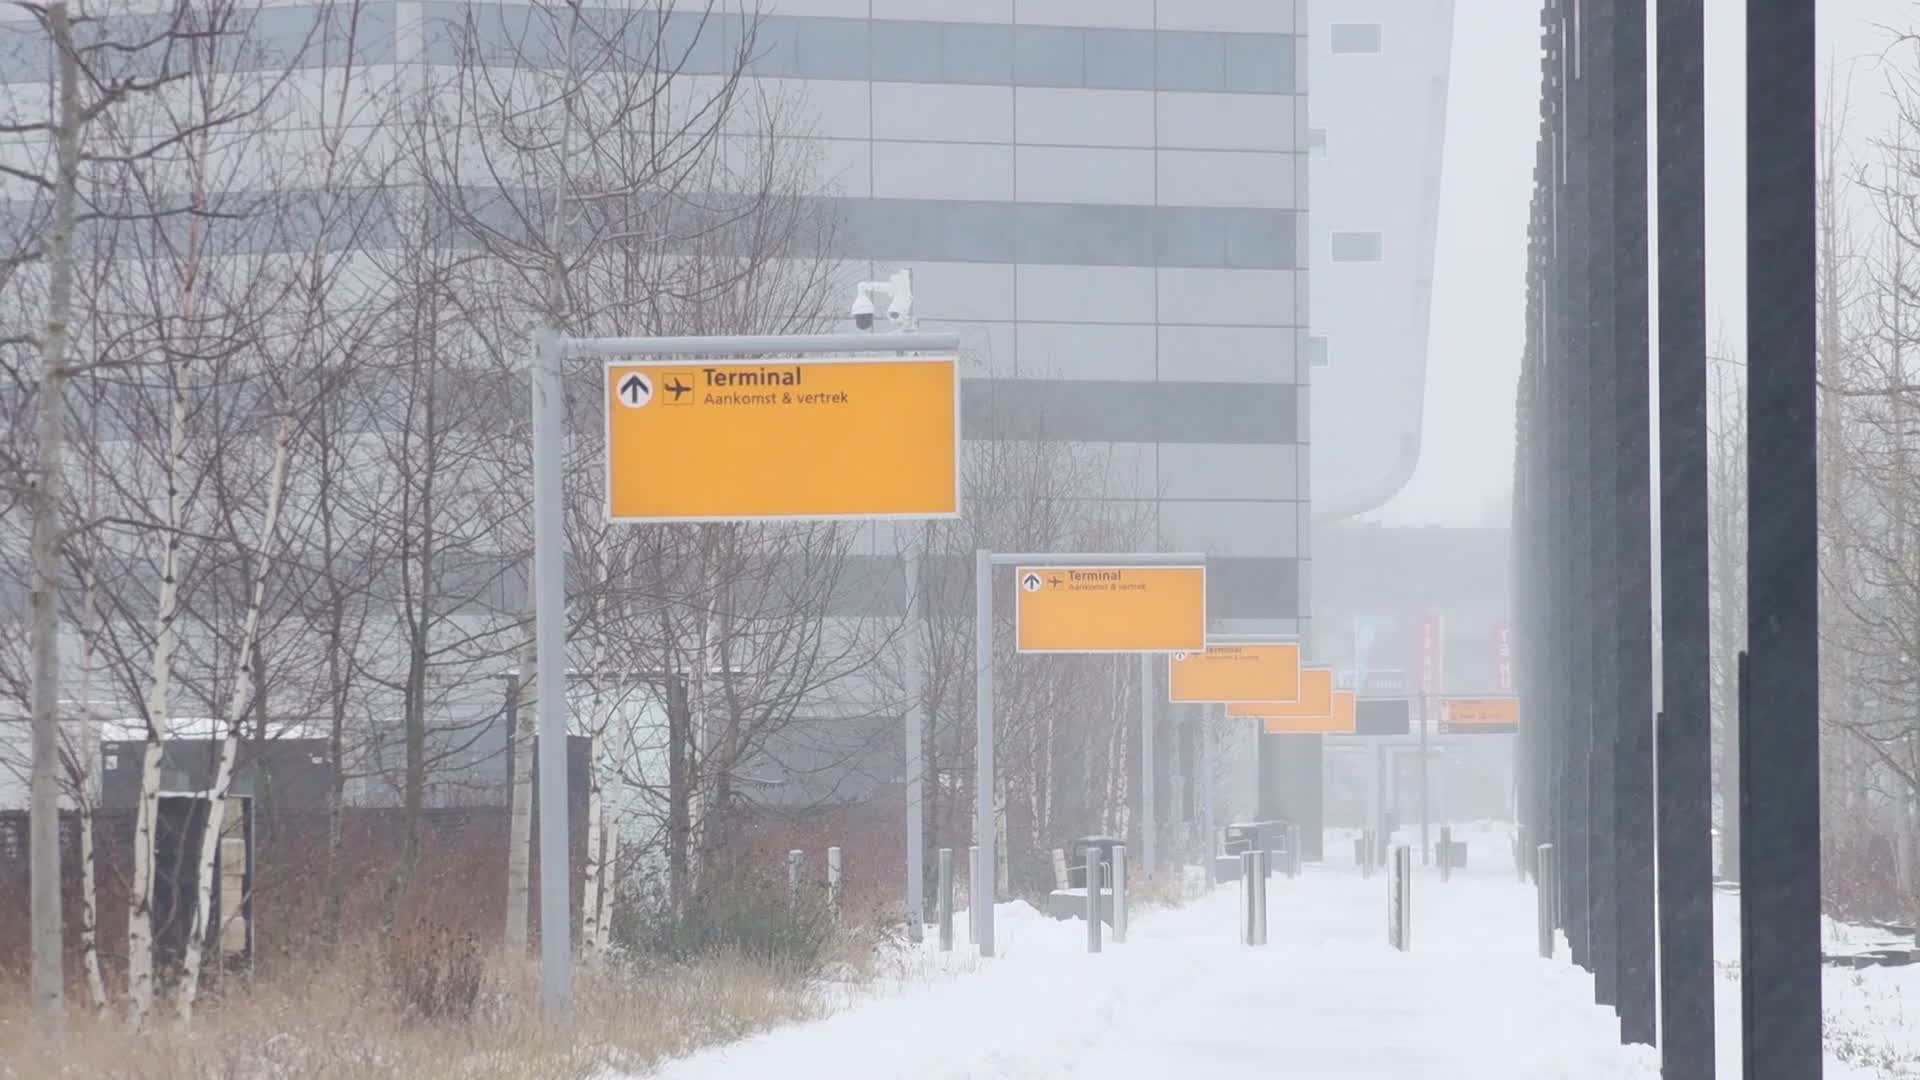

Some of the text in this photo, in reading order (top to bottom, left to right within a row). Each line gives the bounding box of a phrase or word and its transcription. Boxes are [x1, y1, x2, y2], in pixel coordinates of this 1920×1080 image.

[702, 366, 801, 386] Terminal
[703, 390, 849, 405] Aankomst & vertrek
[1068, 569, 1121, 581] Terminal
